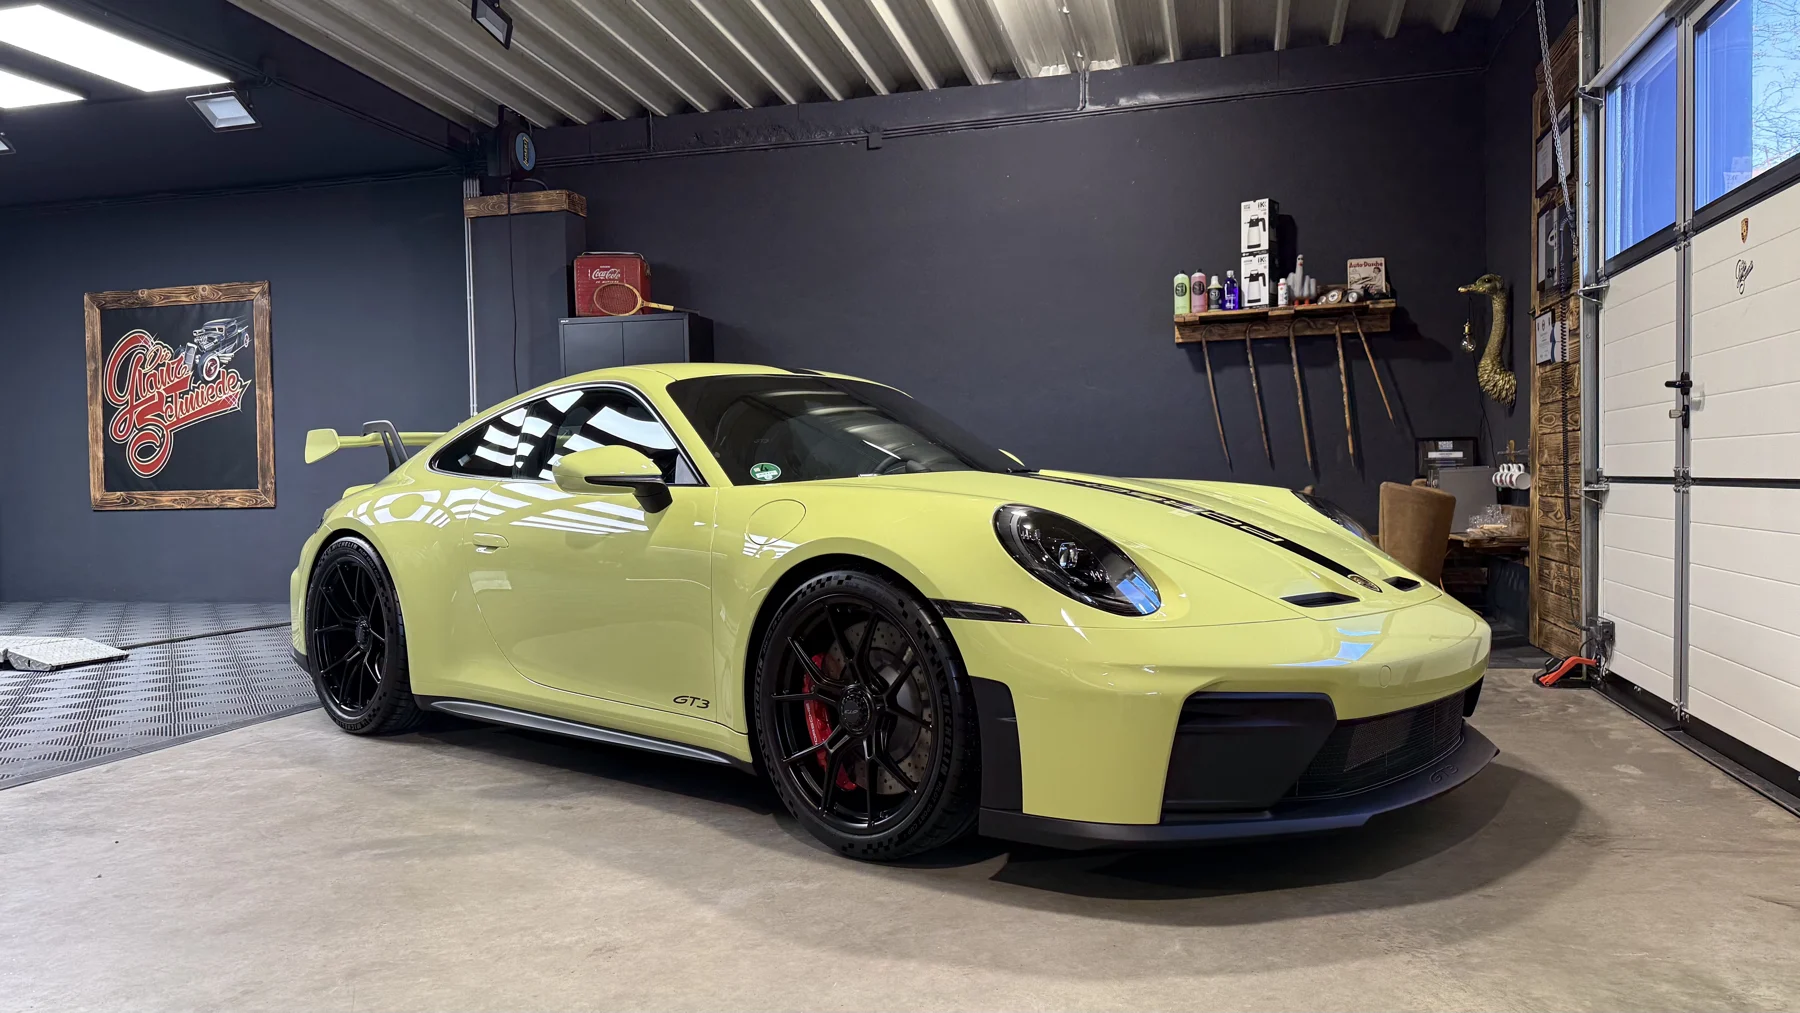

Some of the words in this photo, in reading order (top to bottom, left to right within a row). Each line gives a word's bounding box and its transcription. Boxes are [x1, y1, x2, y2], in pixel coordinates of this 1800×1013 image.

[146, 346, 172, 371] Die
[105, 330, 191, 441] Glanz
[127, 370, 240, 477] Schmiede
[331, 541, 358, 551] MICHELIN
[672, 695, 710, 709] GT3
[940, 692, 953, 777] MICHELIN
[1429, 764, 1459, 784] GT3
[932, 780, 943, 803] PILOT
[918, 803, 933, 825] SPORT
